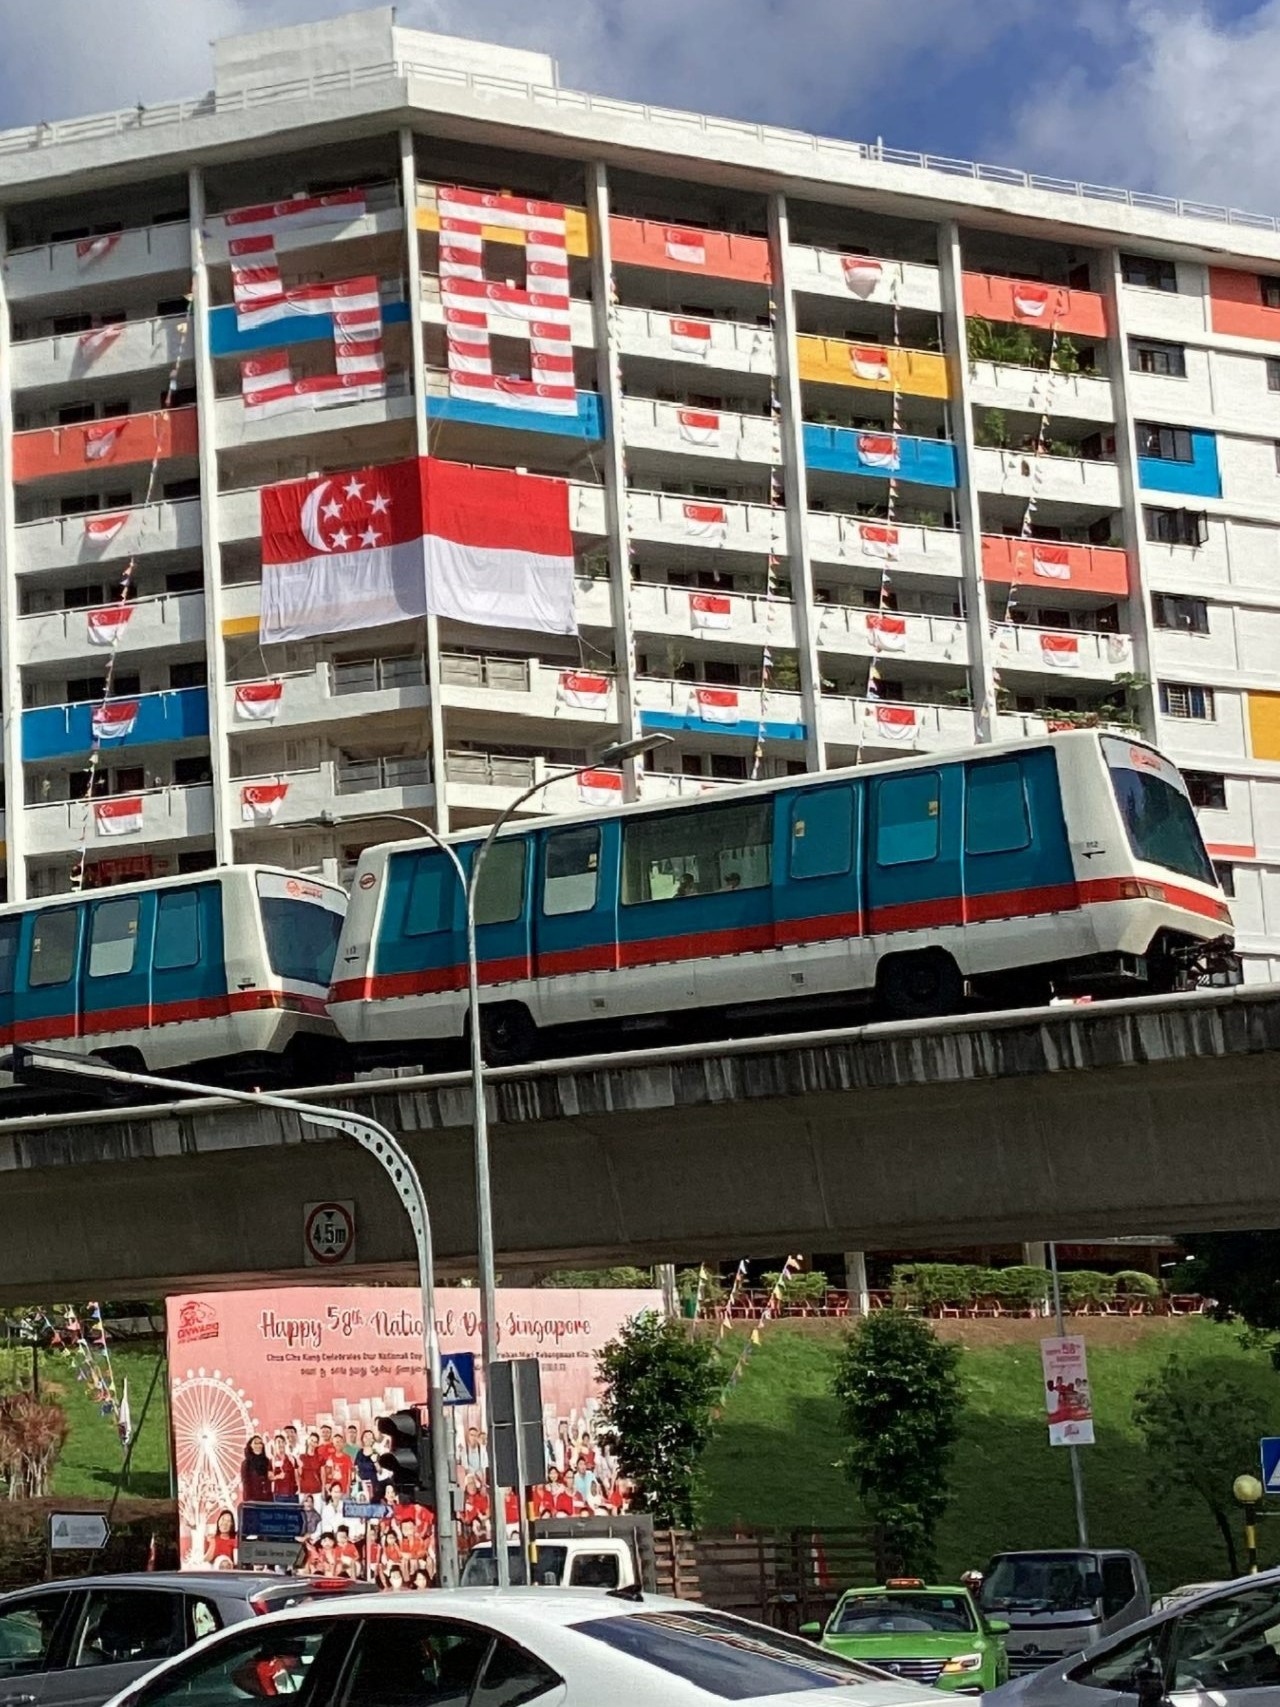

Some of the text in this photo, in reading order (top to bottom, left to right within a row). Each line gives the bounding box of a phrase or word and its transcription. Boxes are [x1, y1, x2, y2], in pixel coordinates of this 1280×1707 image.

[260, 1311, 322, 1348] Happy
[327, 1306, 362, 1336] 58th
[369, 1309, 454, 1337] Natioal
[506, 1311, 591, 1345] Singapore
